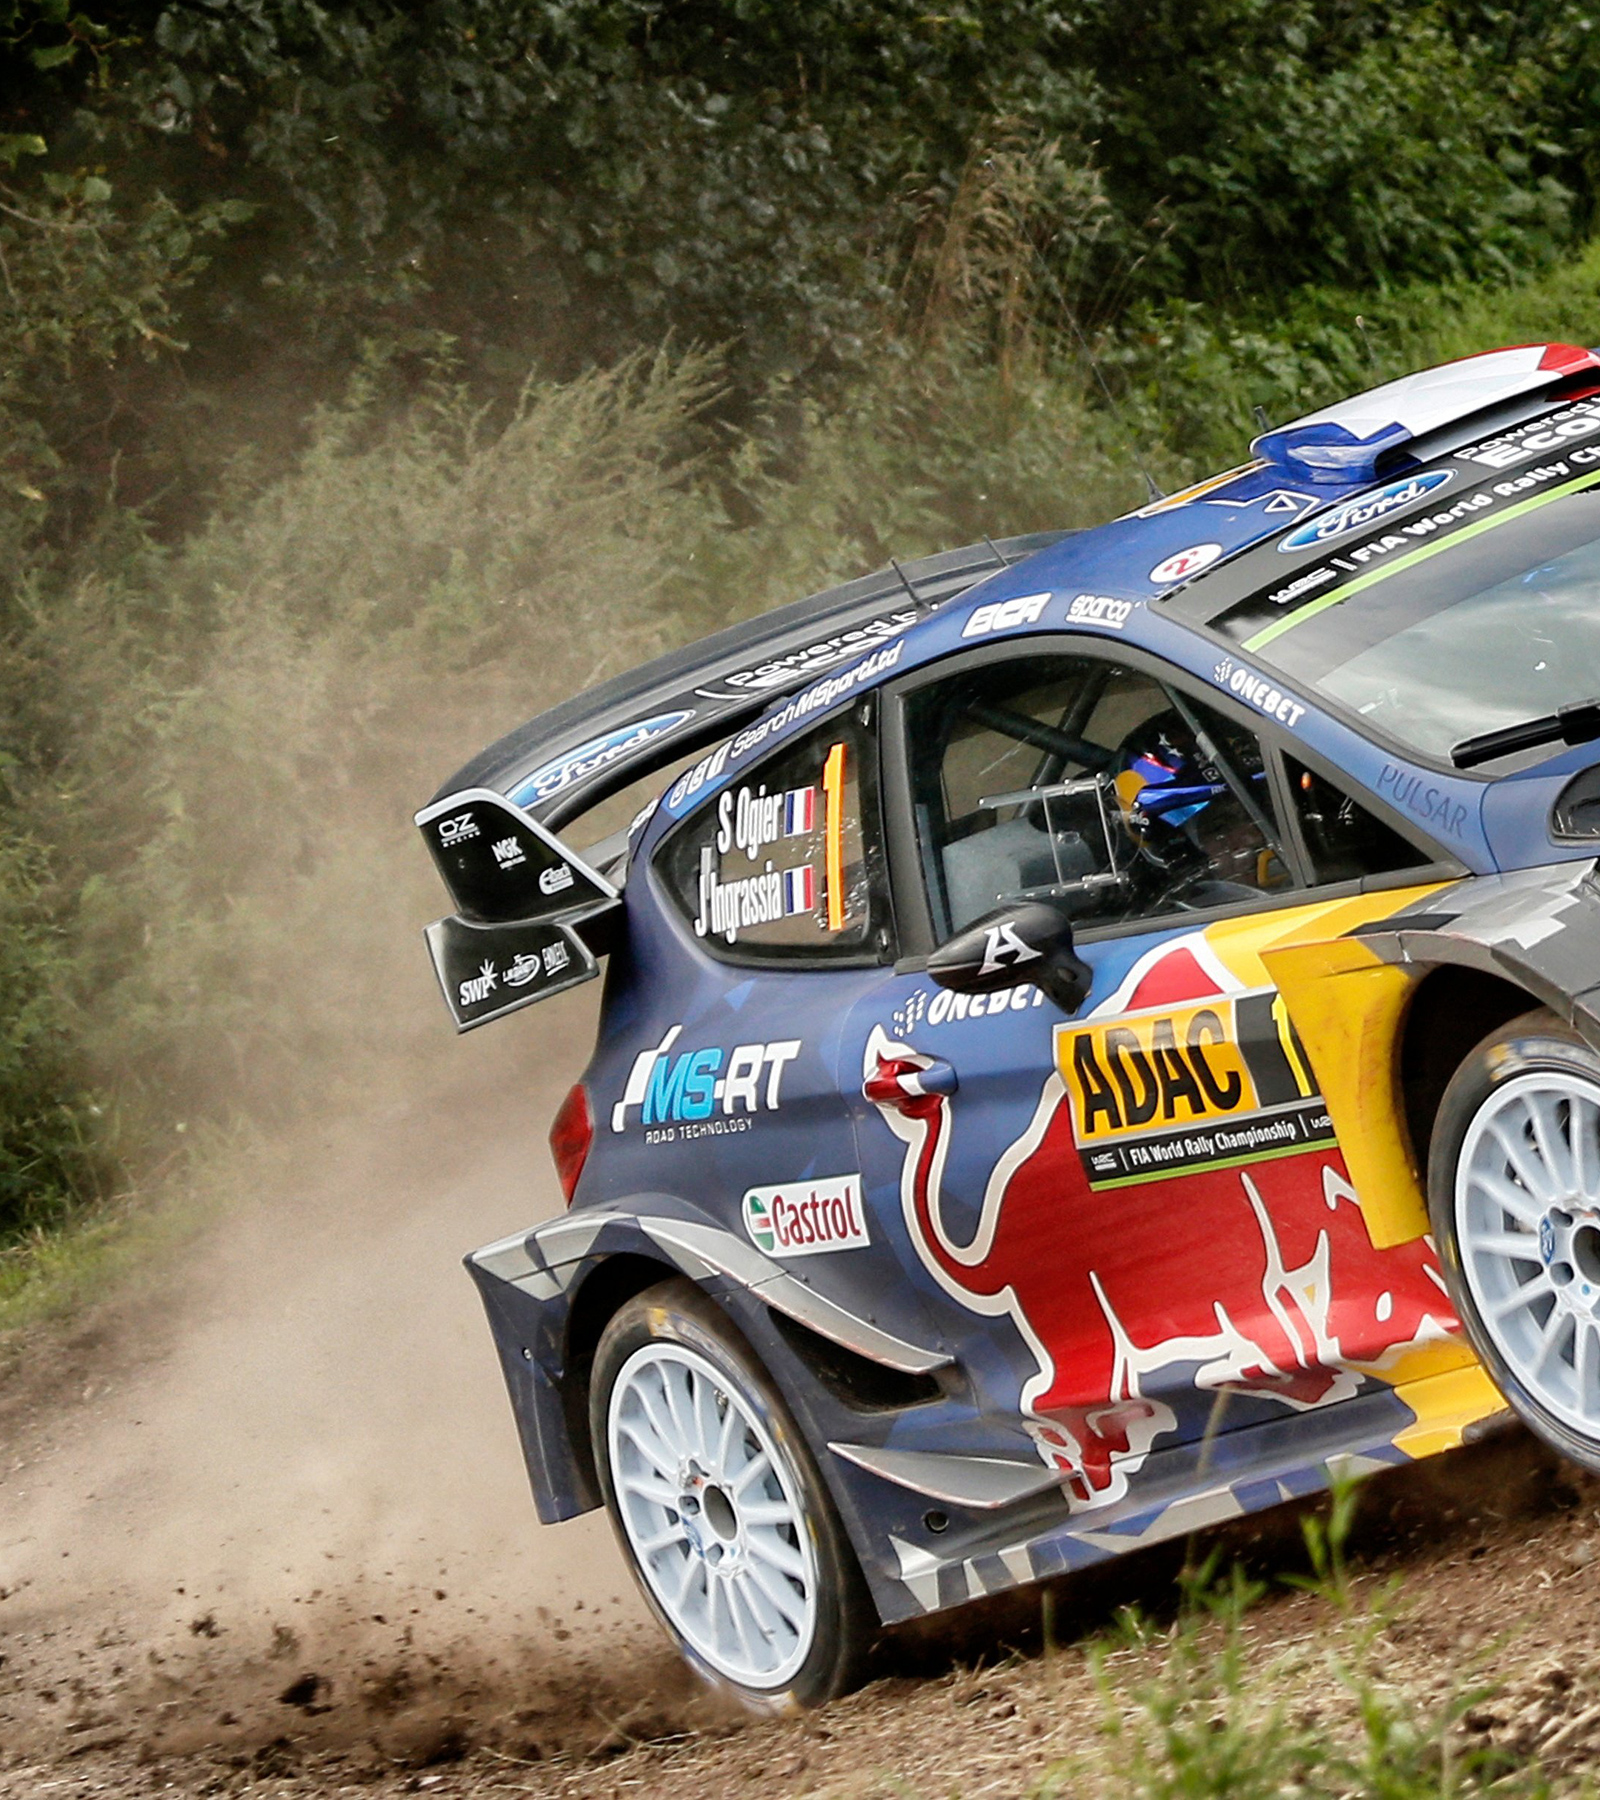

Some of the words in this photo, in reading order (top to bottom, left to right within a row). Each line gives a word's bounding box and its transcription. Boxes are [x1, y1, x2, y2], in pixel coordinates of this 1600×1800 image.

[1453, 402, 1594, 460] Powered
[1316, 481, 1427, 538] Ford
[1350, 535, 1408, 563] FIA
[1402, 492, 1493, 537] World
[1493, 461, 1571, 497] Rally
[1070, 594, 1132, 623] sparco
[725, 618, 891, 687] Powered
[1229, 668, 1306, 729] ONEBET
[532, 728, 661, 799] Ford
[439, 812, 476, 838] OZ
[717, 790, 732, 854] S
[735, 784, 783, 860] Ogier
[1377, 763, 1468, 839] PULSAR
[492, 836, 524, 862] NGK
[823, 742, 847, 931] 1
[694, 873, 707, 937] J
[710, 860, 782, 944] Ingrassia
[460, 976, 492, 1007] SWP
[1072, 1009, 1243, 1135] ADAC
[1271, 992, 1312, 1098] 1
[641, 1039, 801, 1126] MS-RT
[645, 1129, 675, 1146] ROAD
[678, 1117, 753, 1142] TECHNOLOGY
[1129, 1146, 1150, 1166] FIA
[1150, 1140, 1182, 1163] World
[1185, 1132, 1215, 1155] Rally
[1214, 1120, 1297, 1150] Championship
[772, 1185, 861, 1248] Castrol
